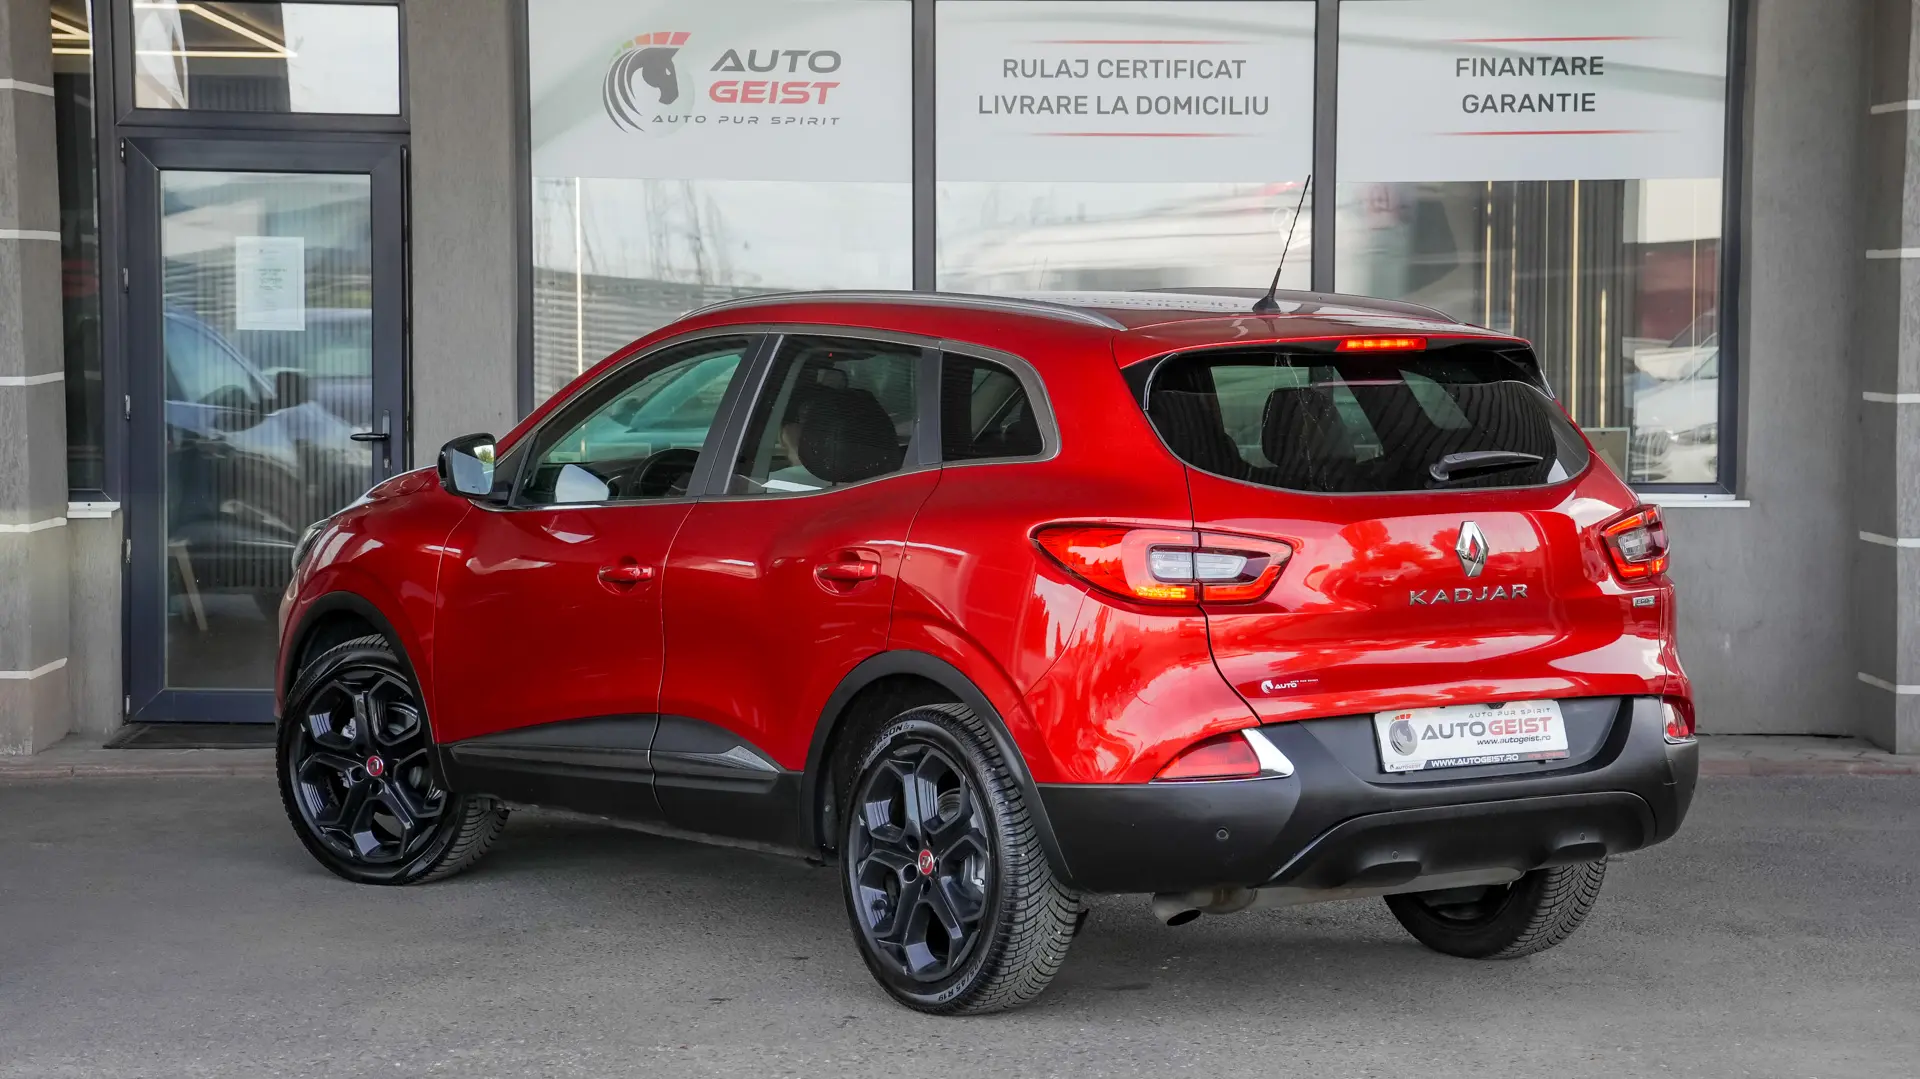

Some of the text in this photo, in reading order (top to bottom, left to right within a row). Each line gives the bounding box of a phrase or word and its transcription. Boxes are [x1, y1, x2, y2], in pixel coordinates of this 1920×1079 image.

[709, 48, 842, 74] AUTO
[1002, 58, 1247, 79] RULAJ CERTIFICAT
[1455, 56, 1605, 77] FINANTARE
[708, 80, 841, 105] GEIST
[1462, 92, 1596, 113] GARANTIE
[978, 95, 1269, 116] LIVRARE LA DOMICILIU
[652, 115, 841, 126] AUTO PUR SPIRIT
[1408, 583, 1529, 606] KADJAR
[1468, 707, 1551, 719] AUTO PUR SPIRIT
[1476, 734, 1552, 746] www.autogeist.ro
[1430, 753, 1519, 768] WWW.AUTOGEIST.RO
